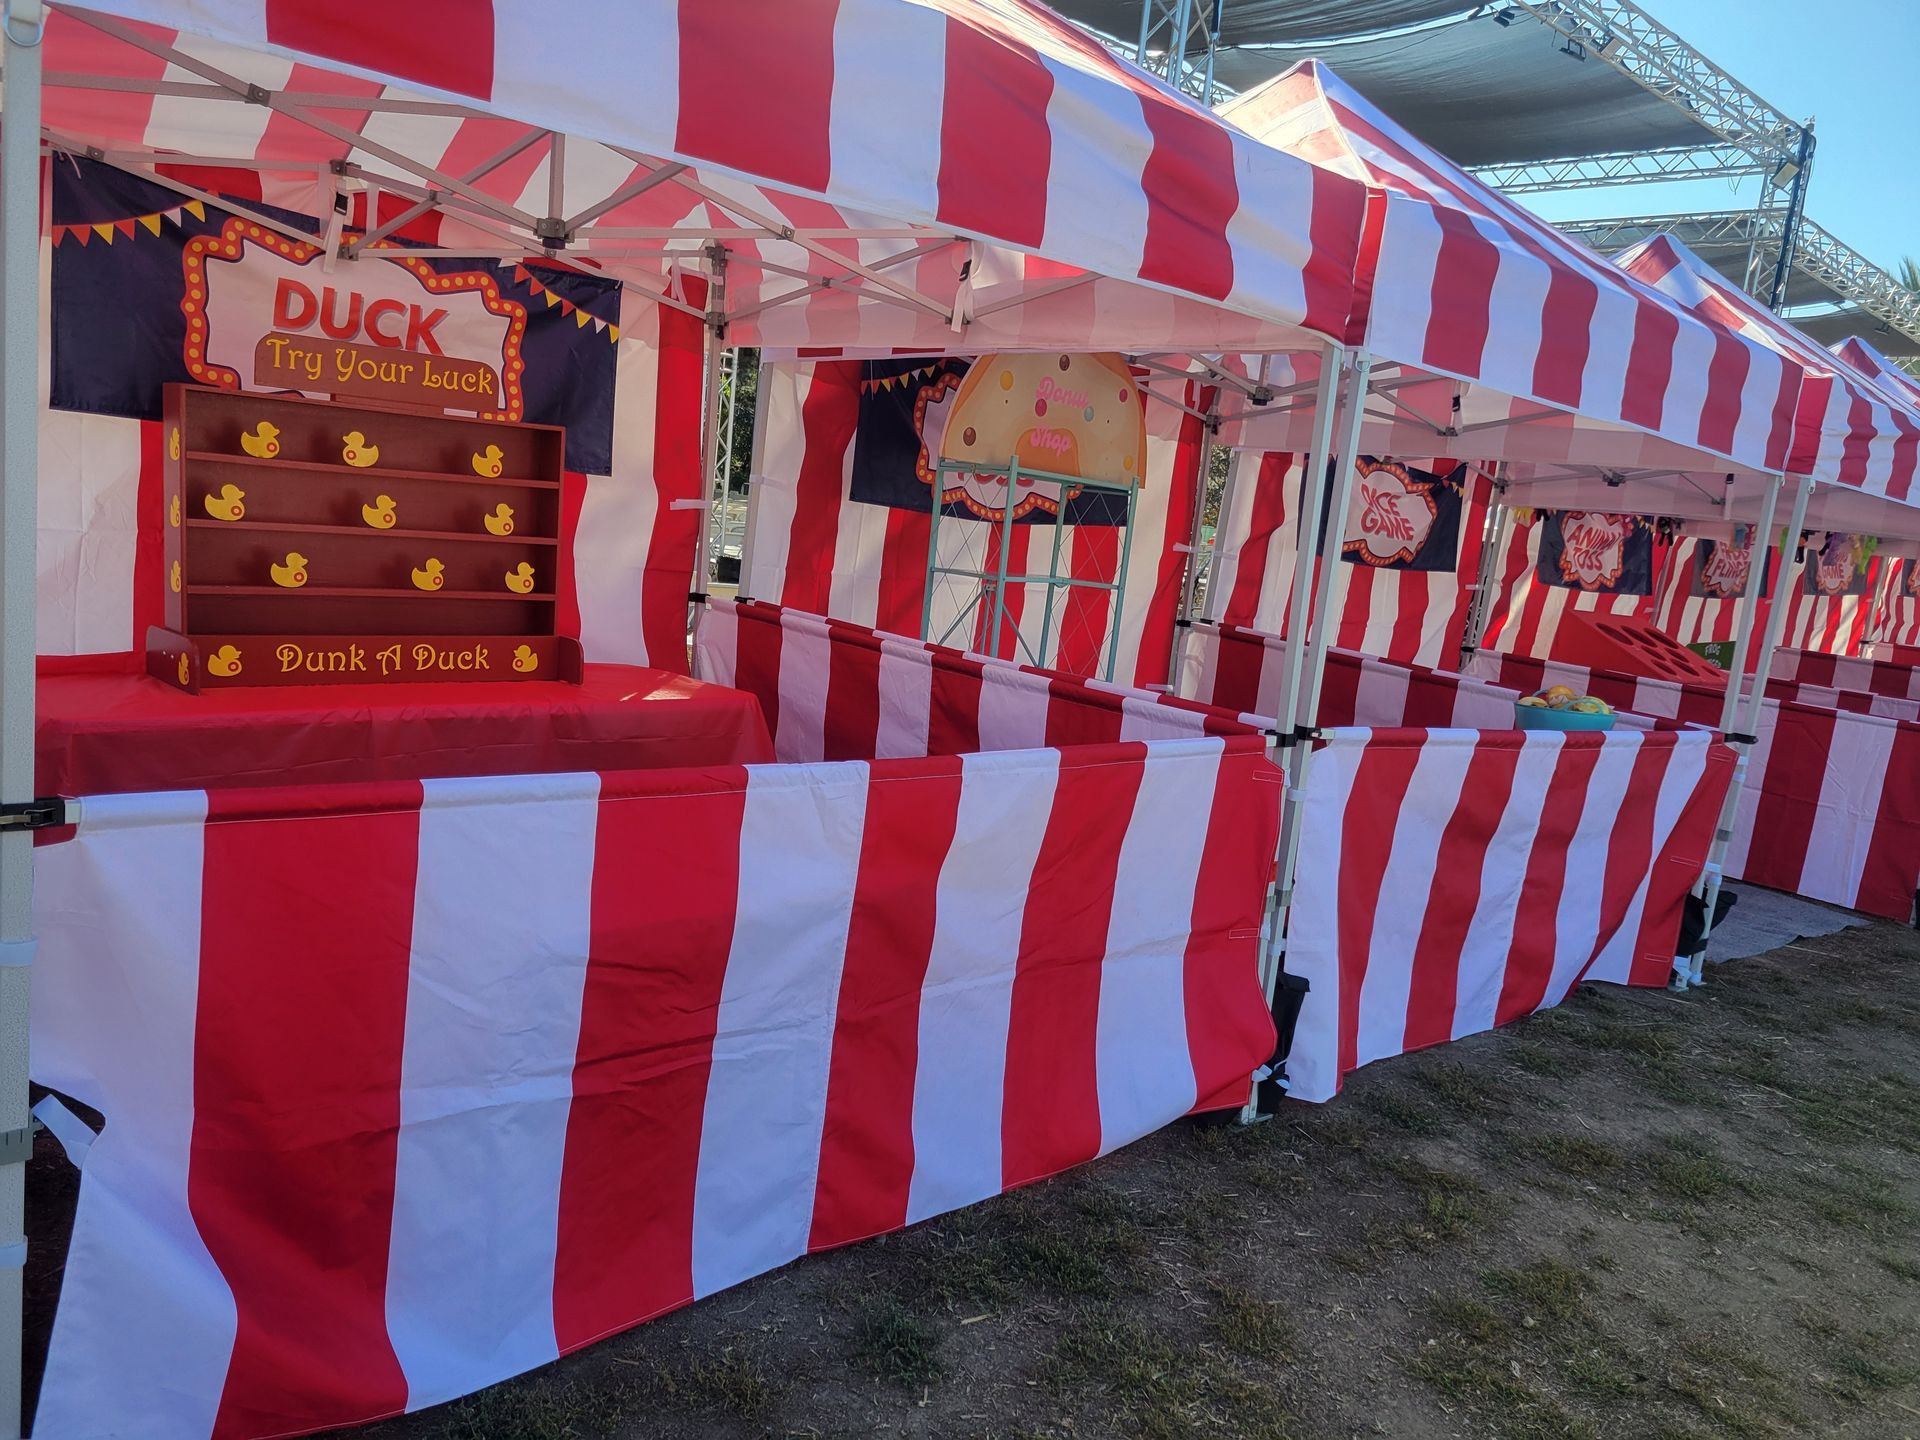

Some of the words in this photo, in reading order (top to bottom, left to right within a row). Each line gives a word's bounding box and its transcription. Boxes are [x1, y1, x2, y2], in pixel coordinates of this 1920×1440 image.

[273, 277, 449, 356] DUCK
[266, 338, 322, 380] Try
[336, 348, 414, 382] Your
[422, 360, 493, 395] Luck
[1030, 424, 1072, 457] Shop
[1361, 484, 1402, 517] DICE
[1361, 507, 1415, 541] GAME
[1573, 547, 1604, 571] TOSS
[276, 643, 367, 672] Dunk
[375, 644, 402, 676] A
[412, 643, 490, 671] Duck
